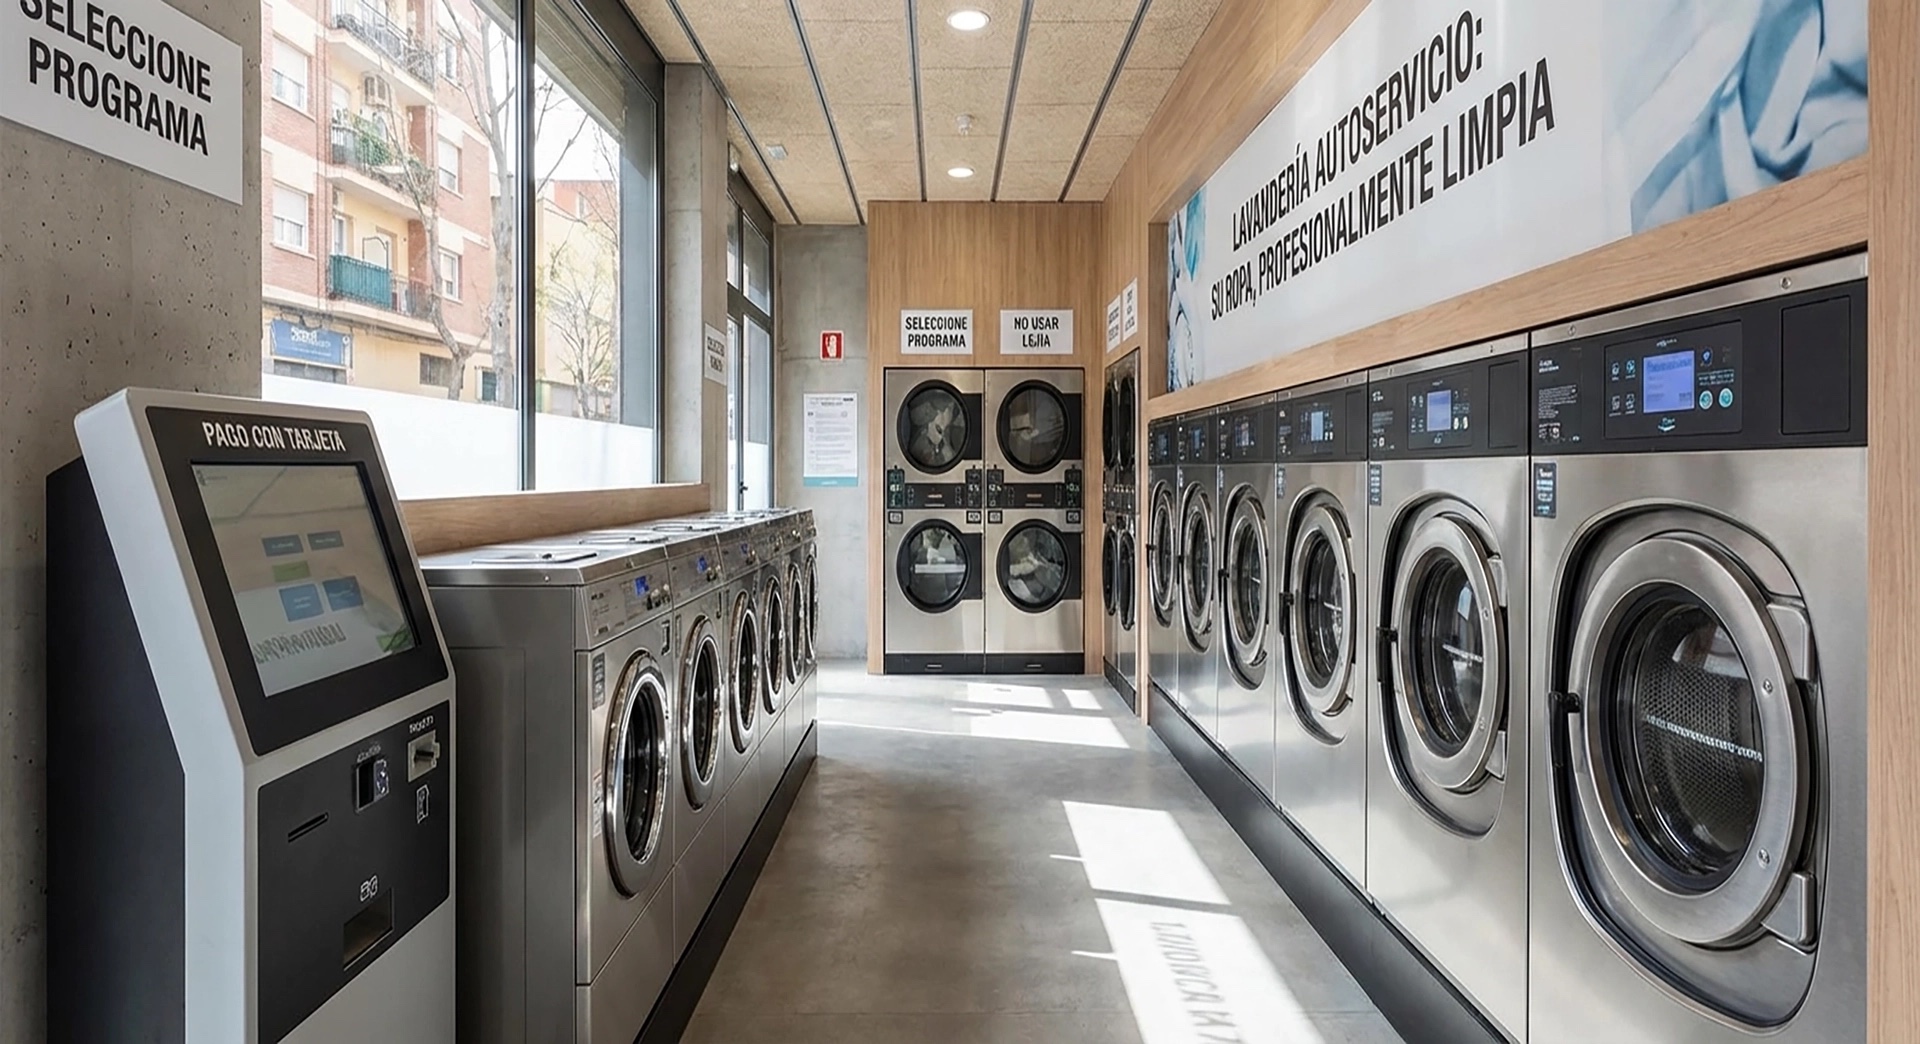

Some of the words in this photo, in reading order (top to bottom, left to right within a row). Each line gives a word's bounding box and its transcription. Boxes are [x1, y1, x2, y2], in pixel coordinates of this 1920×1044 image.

[29, 37, 208, 157] PROGRAMA
[1232, 143, 1310, 251] LAVANDERÍA
[1314, 10, 1482, 193] AUTOSERVICIO:
[1211, 279, 1223, 321] SU
[1225, 261, 1257, 308] ROPA,
[1258, 135, 1434, 297] PROFESIONALMENTE
[1443, 57, 1555, 191] LIMPIA
[905, 316, 968, 331] SELECCIONE
[1014, 316, 1029, 331] NO
[1031, 316, 1060, 331] USAR
[907, 333, 967, 348] PROGRAMA
[202, 421, 250, 448] PAGO
[251, 424, 286, 450] CON
[284, 426, 347, 452] TARJETA
